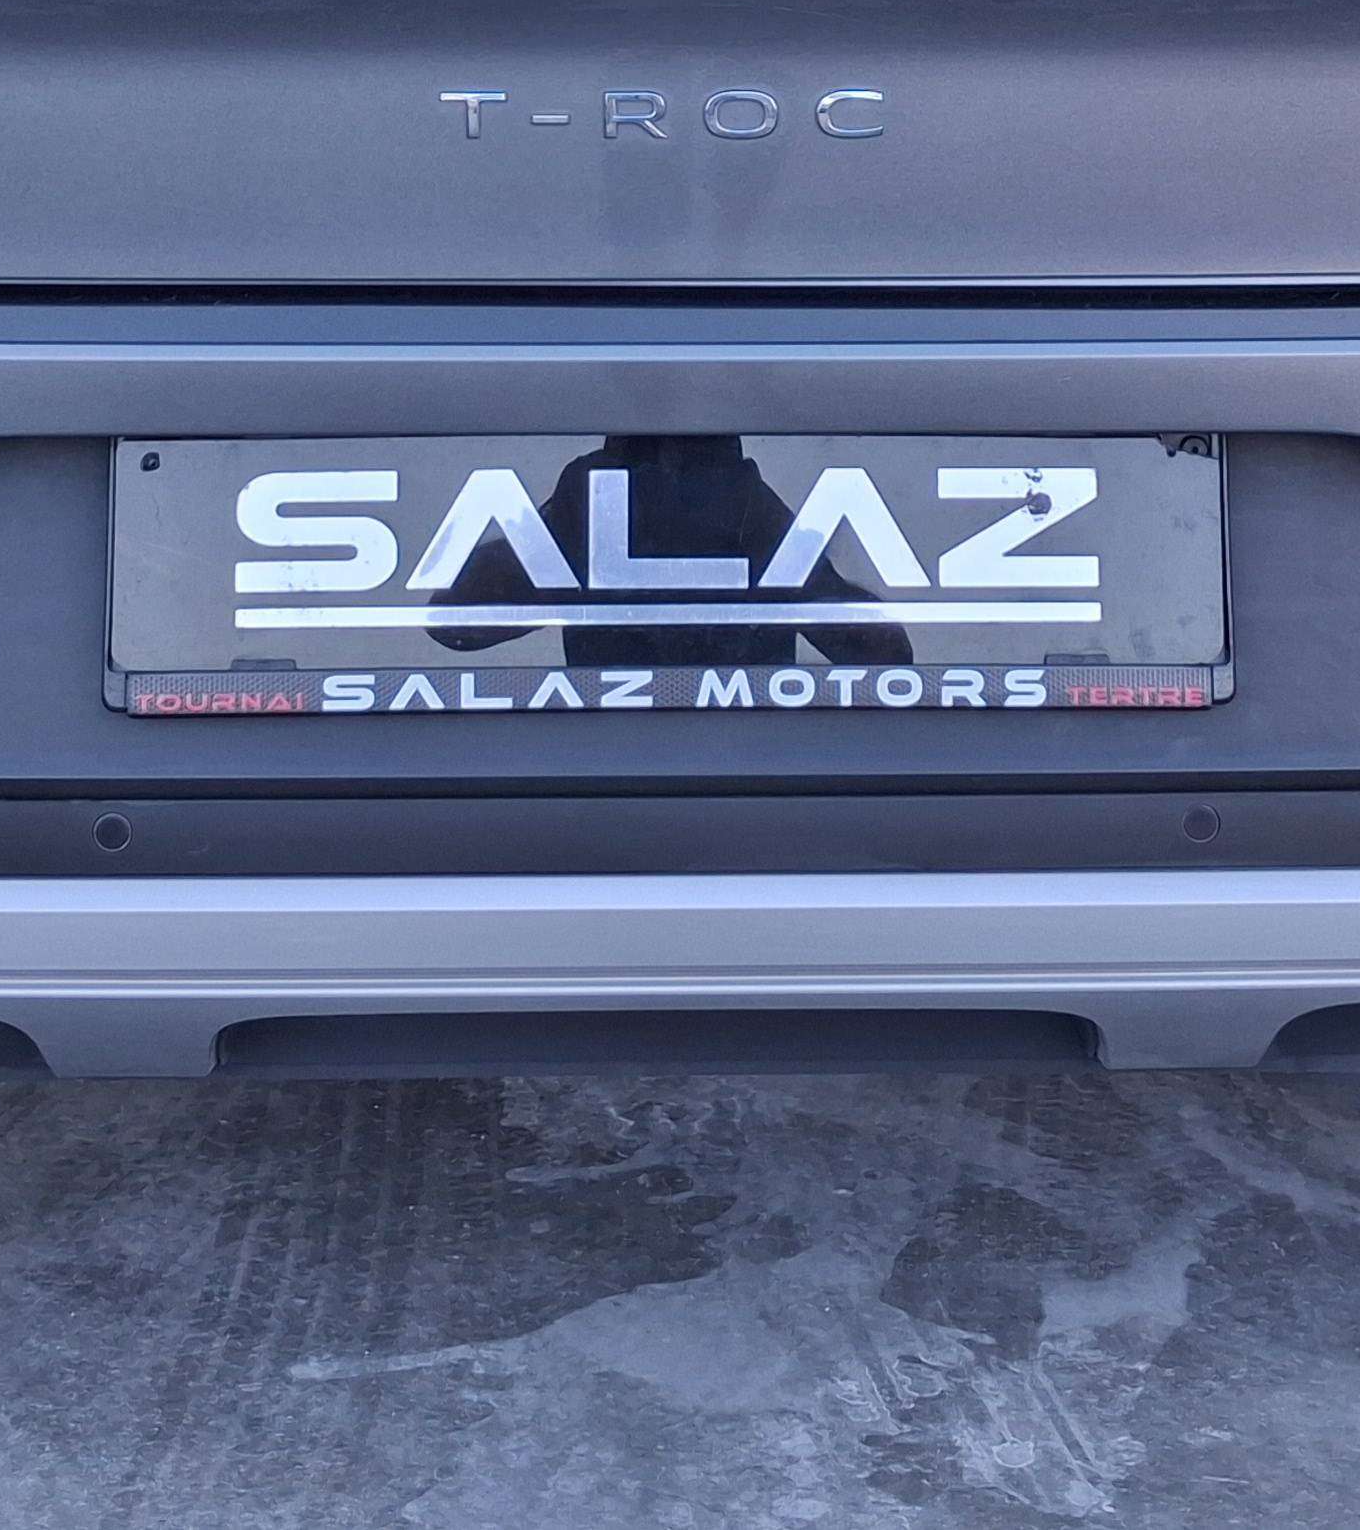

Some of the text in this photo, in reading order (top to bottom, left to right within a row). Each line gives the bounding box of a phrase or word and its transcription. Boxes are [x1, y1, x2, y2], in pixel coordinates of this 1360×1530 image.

[438, 87, 886, 140] T-ROC
[233, 467, 1101, 595] SALAZ
[136, 668, 1206, 713] TOURNAI SALAZ MOTORS TERTRE
